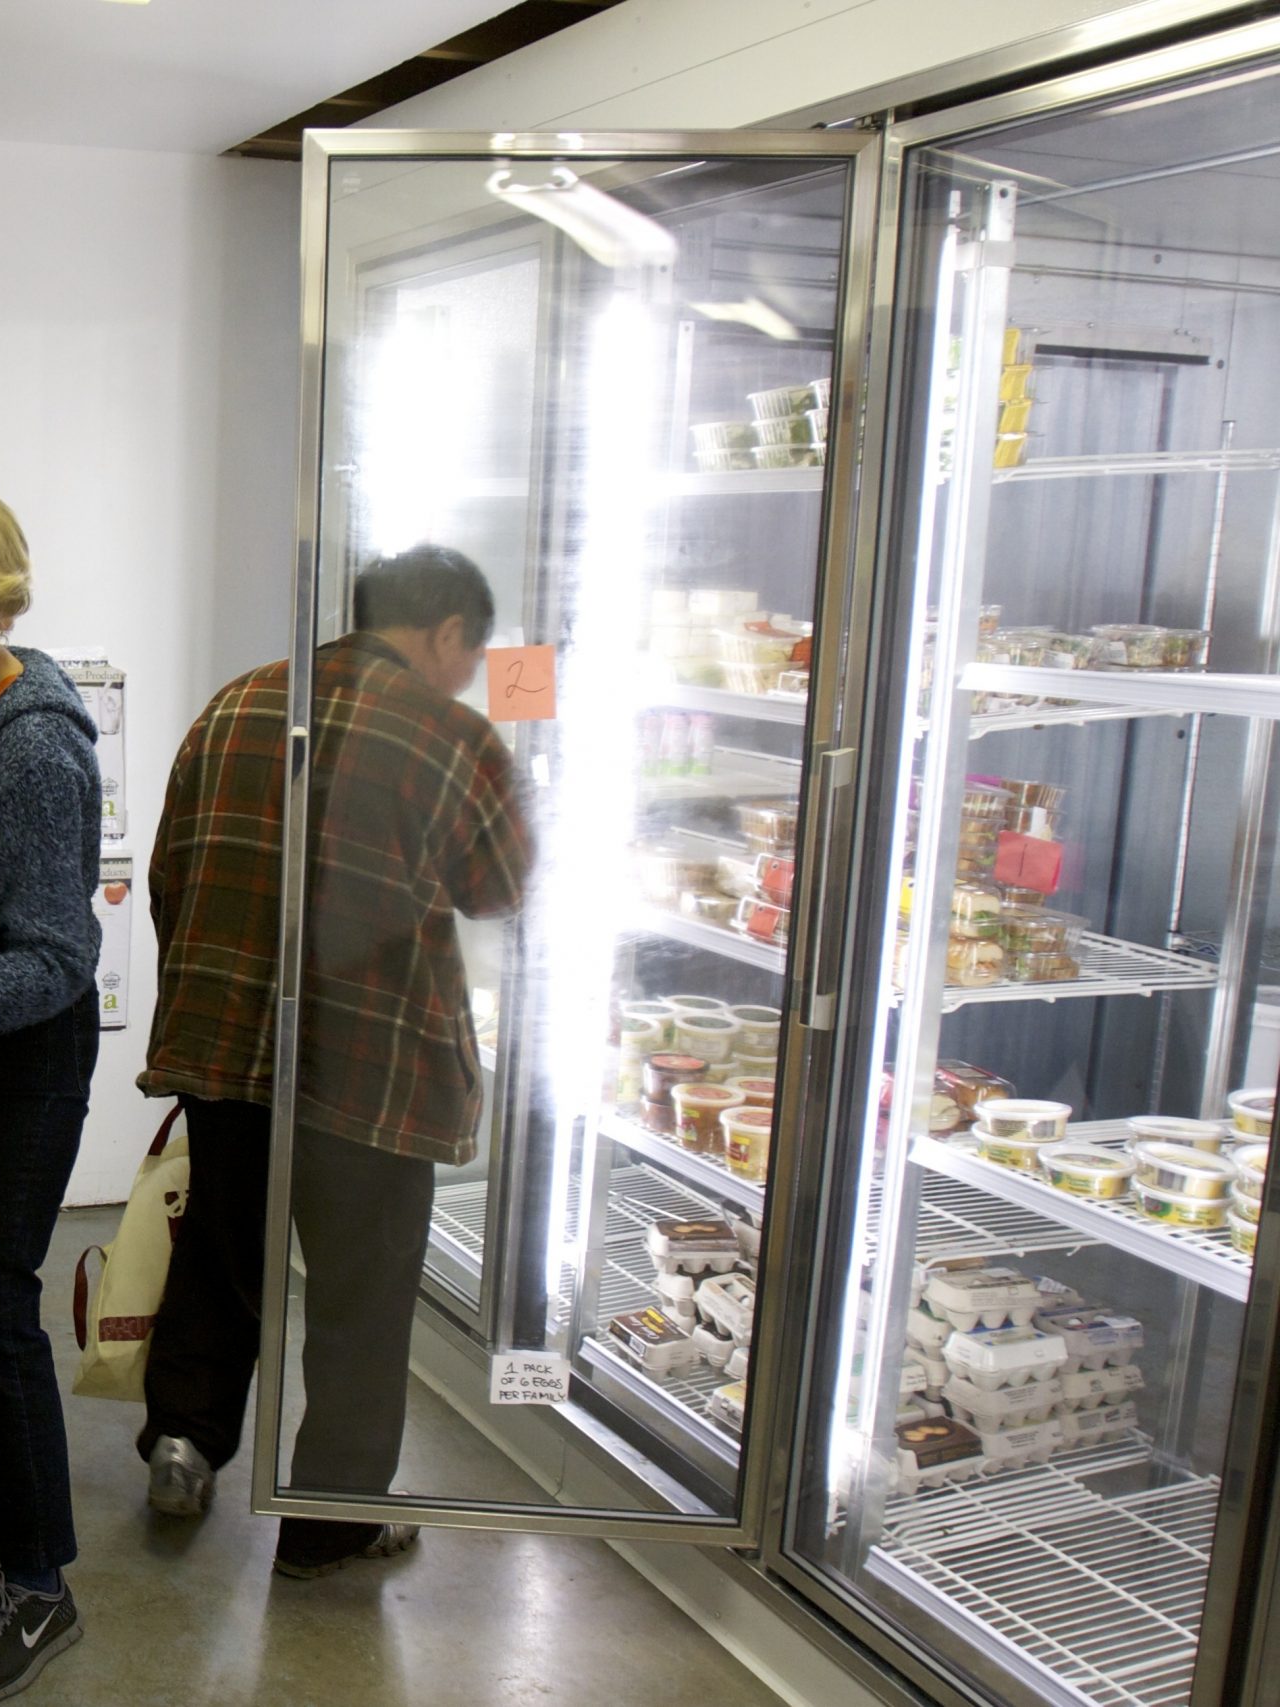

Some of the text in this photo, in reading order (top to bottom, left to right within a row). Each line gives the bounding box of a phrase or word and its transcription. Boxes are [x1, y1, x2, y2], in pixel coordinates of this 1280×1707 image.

[505, 660, 549, 699] 2
[504, 1362, 553, 1375] 1 PACK
[500, 1377, 563, 1389] OF 6 EGGS
[499, 1390, 567, 1403] PER FAMILY
